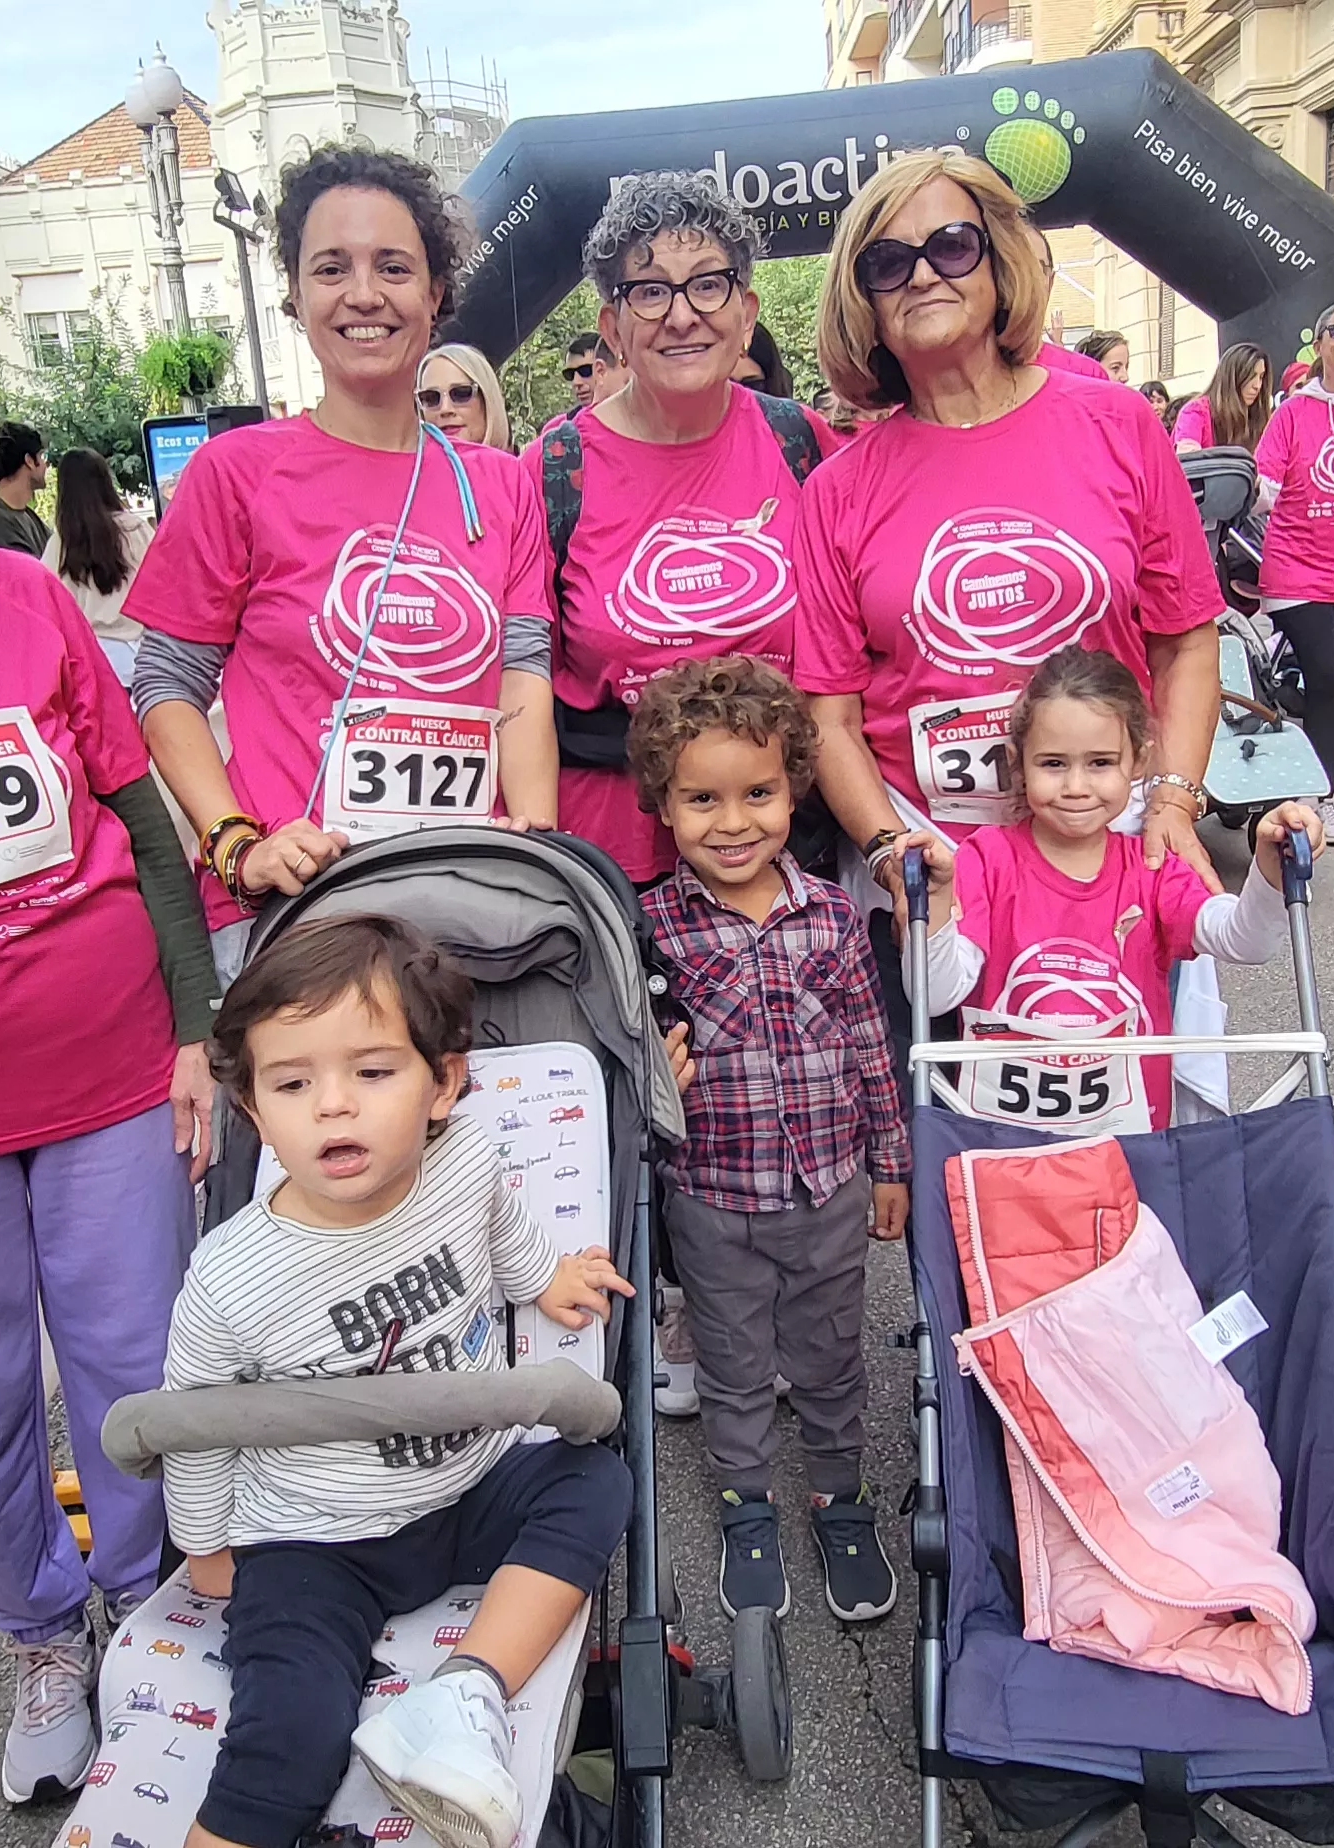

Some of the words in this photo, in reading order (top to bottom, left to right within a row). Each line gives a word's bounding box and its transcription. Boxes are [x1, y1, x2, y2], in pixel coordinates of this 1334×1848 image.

[1133, 118, 1176, 166] Pisa
[1174, 153, 1218, 204] bien,
[1221, 193, 1260, 230] vive
[1257, 222, 1316, 271] mejor
[460, 239, 496, 275] vive
[491, 184, 540, 242] mejor
[799, 215, 811, 227] Y
[156, 435, 182, 448] Ecos
[668, 572, 723, 593] JUNTOS
[960, 570, 1028, 592] Caminemos
[967, 585, 1026, 611] JUNTOS
[378, 607, 434, 625] JUNTOS
[411, 717, 452, 731] HUESCA
[986, 709, 1012, 722] HUE
[354, 727, 422, 744] CONTRA
[425, 730, 440, 745] EL
[442, 730, 486, 748] CÁNCER
[935, 723, 1001, 742] CONTRA
[348, 749, 487, 808] 3127
[937, 743, 1013, 794] 31
[996, 1061, 1111, 1118] 555
[327, 1243, 467, 1354] BORN
